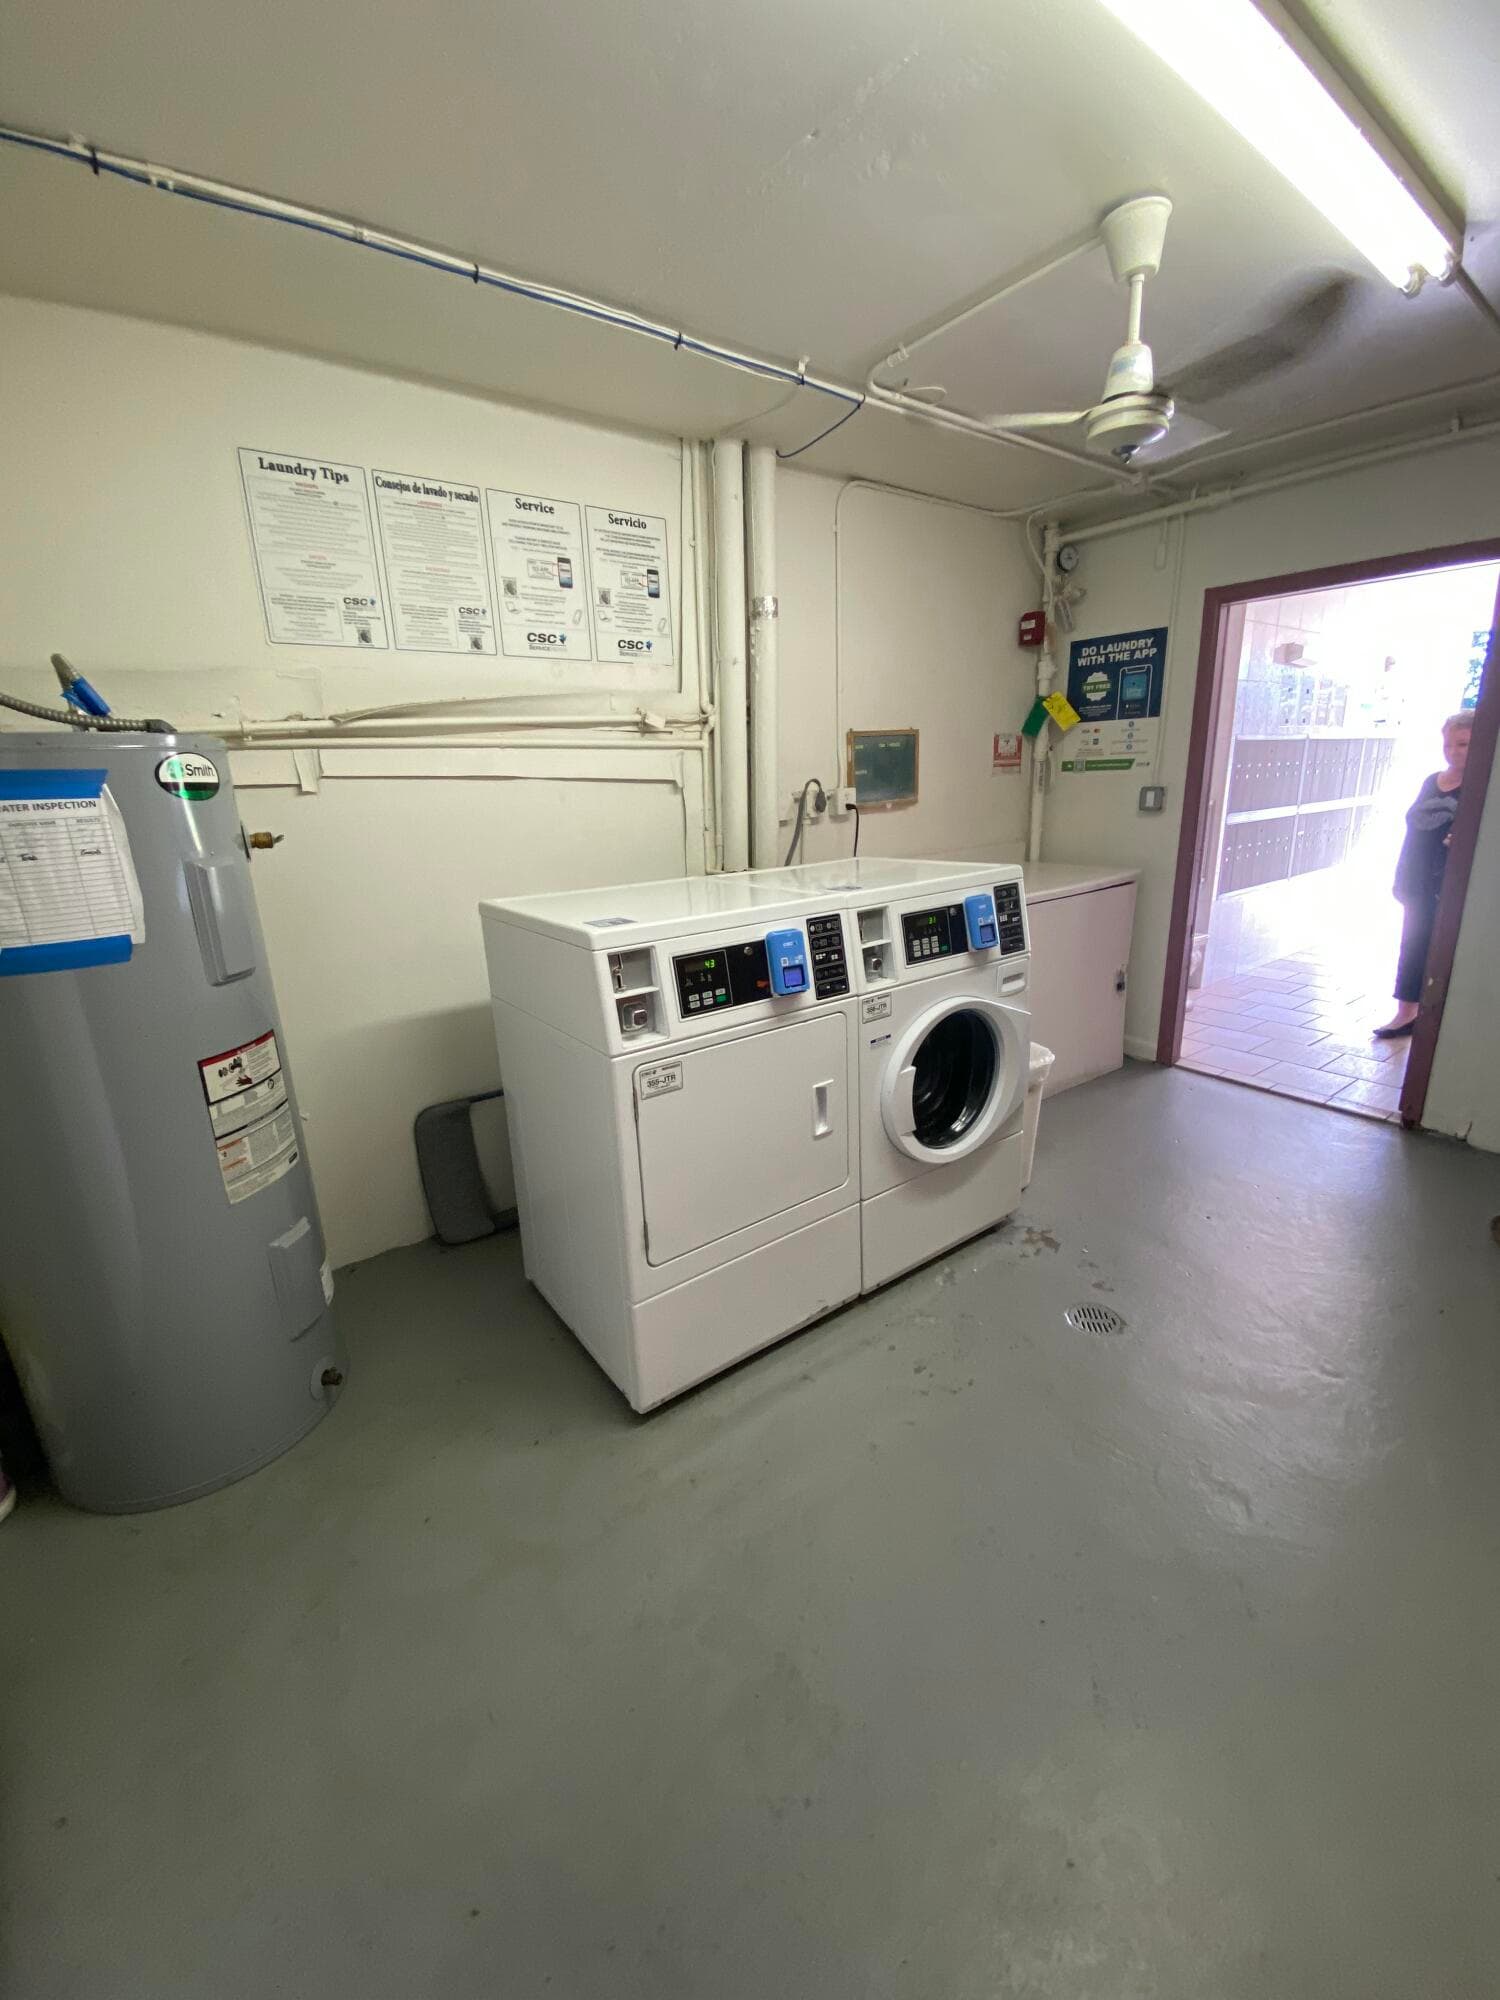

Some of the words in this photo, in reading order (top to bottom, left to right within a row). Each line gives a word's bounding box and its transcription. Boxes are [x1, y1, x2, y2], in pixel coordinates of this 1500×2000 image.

[257, 456, 317, 481] Laundry
[319, 466, 350, 485] Tips
[375, 475, 411, 494] Consejos
[412, 481, 422, 494] de
[422, 483, 448, 498] lavado
[448, 490, 455, 502] y
[454, 490, 479, 503] secado
[515, 497, 555, 515] Service
[608, 513, 647, 530] Servicio
[343, 597, 369, 606] CSC
[458, 606, 481, 615] CSC
[526, 632, 557, 644] CSC
[617, 639, 644, 650] CSC
[1082, 646, 1097, 657] DO
[1100, 637, 1154, 654] LAUNDRY
[1077, 654, 1106, 667] WITH
[1108, 651, 1132, 663] THE
[1133, 647, 1158, 660] APP
[184, 763, 215, 777] Smith
[0, 803, 30, 813] ATER
[32, 800, 97, 811] INSPECTION
[704, 959, 716, 968] 43
